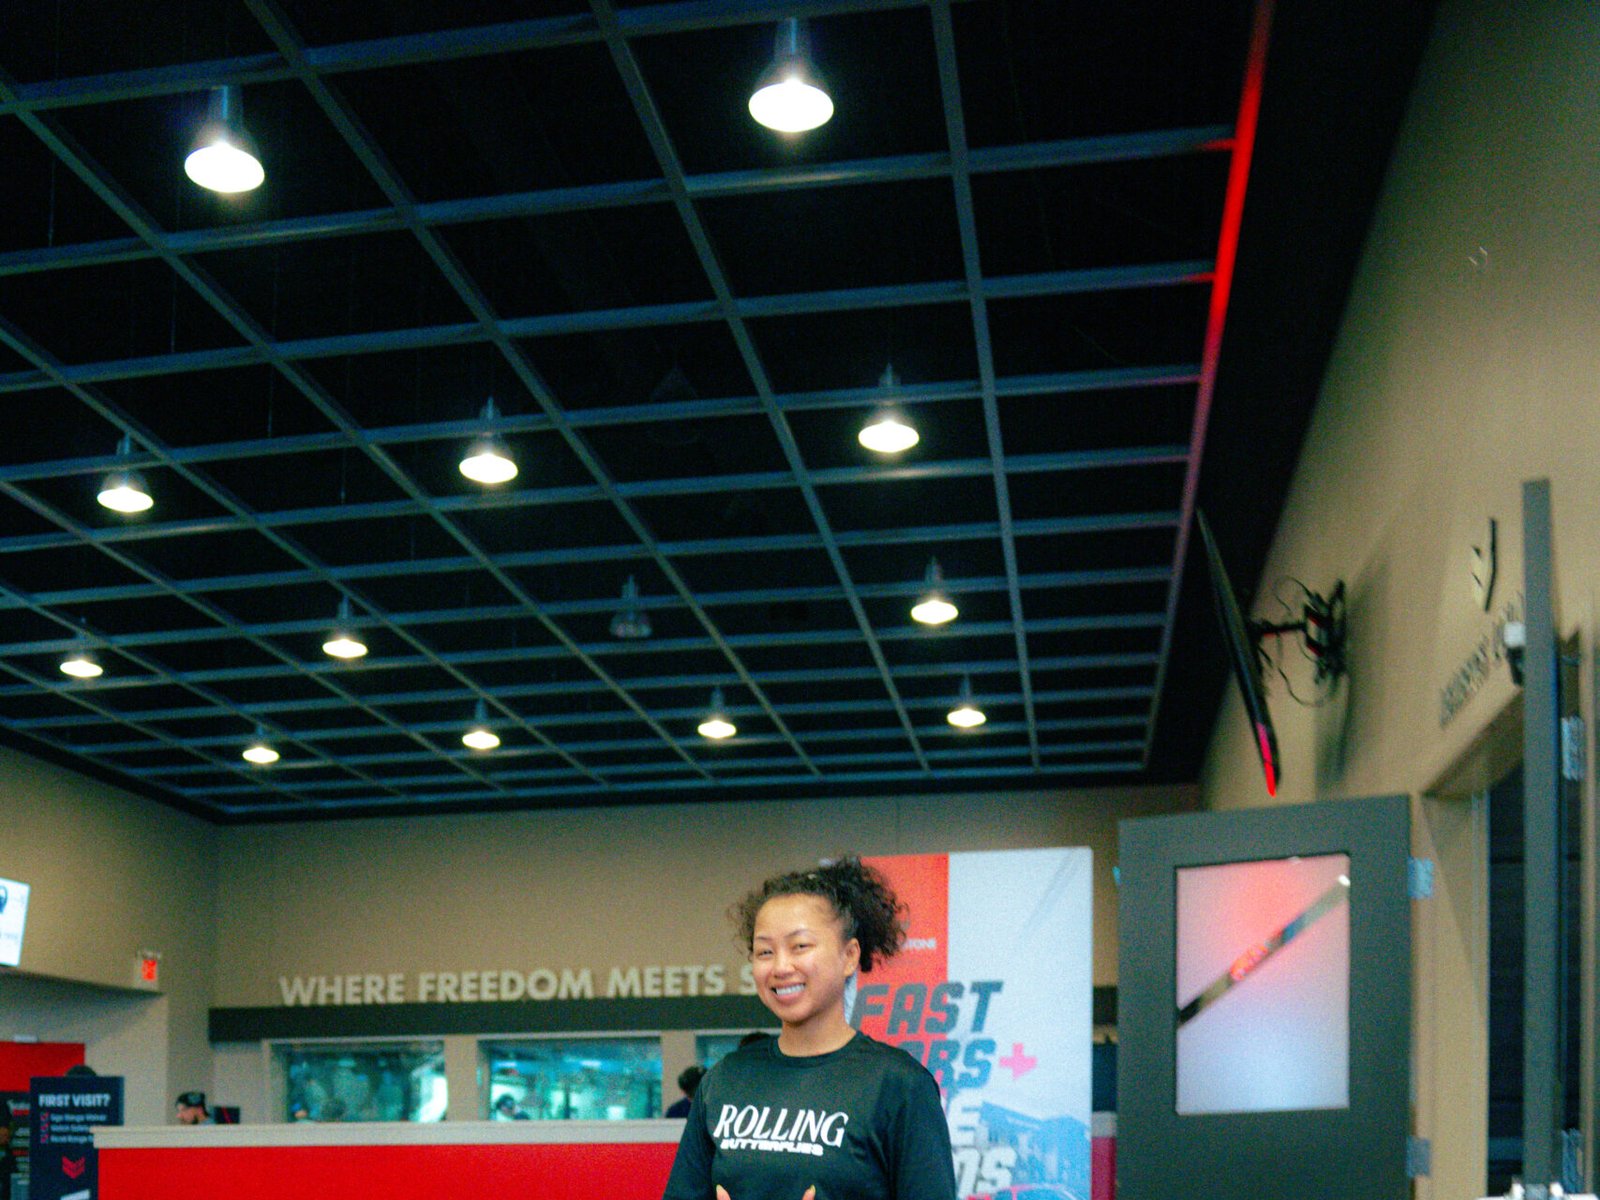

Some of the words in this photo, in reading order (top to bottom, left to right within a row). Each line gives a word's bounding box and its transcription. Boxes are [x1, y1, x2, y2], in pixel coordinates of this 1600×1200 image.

[279, 974, 404, 1007] WHERE
[418, 967, 595, 1003] FREEDOM
[607, 963, 726, 999] MEETS
[851, 980, 1003, 1036] FAST
[38, 1093, 70, 1107] FIRST
[71, 1093, 111, 1107] VISIT?
[713, 1104, 849, 1148] ROLLING
